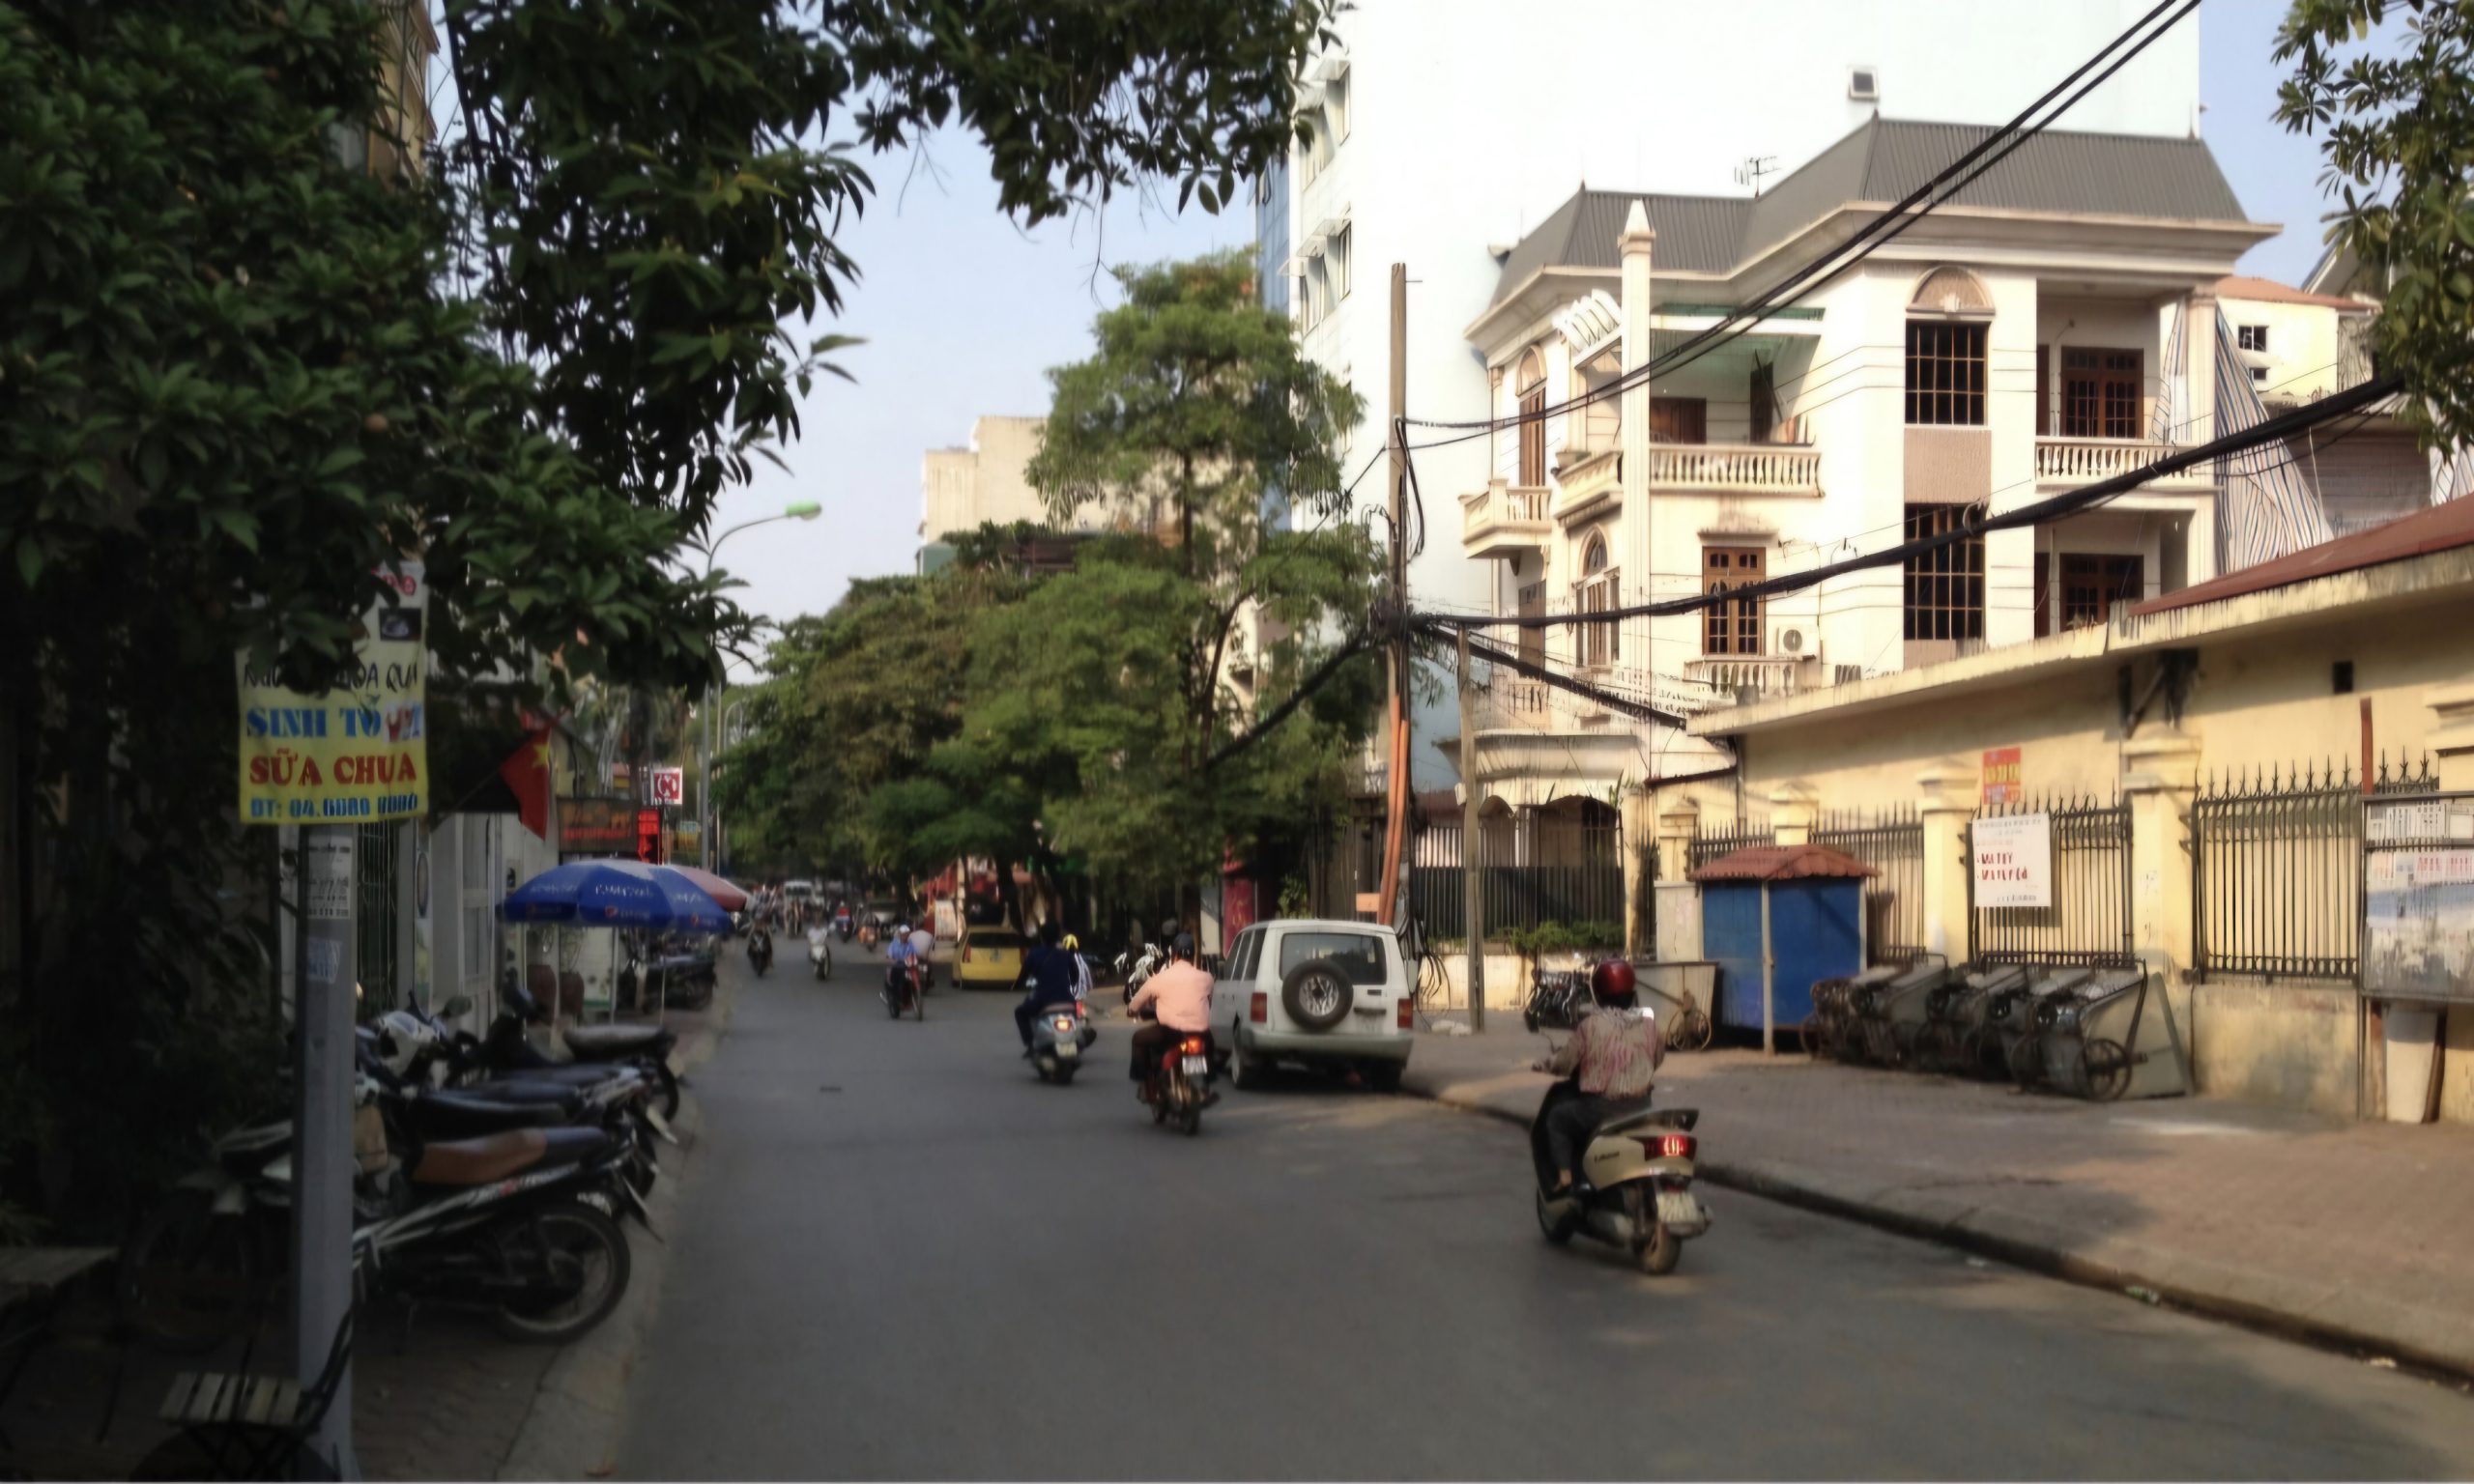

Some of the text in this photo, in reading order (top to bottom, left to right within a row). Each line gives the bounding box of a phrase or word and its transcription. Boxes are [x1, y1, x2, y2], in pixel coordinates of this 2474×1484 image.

[246, 708, 327, 737] SINH
[248, 748, 417, 786] SỮA CHUA
